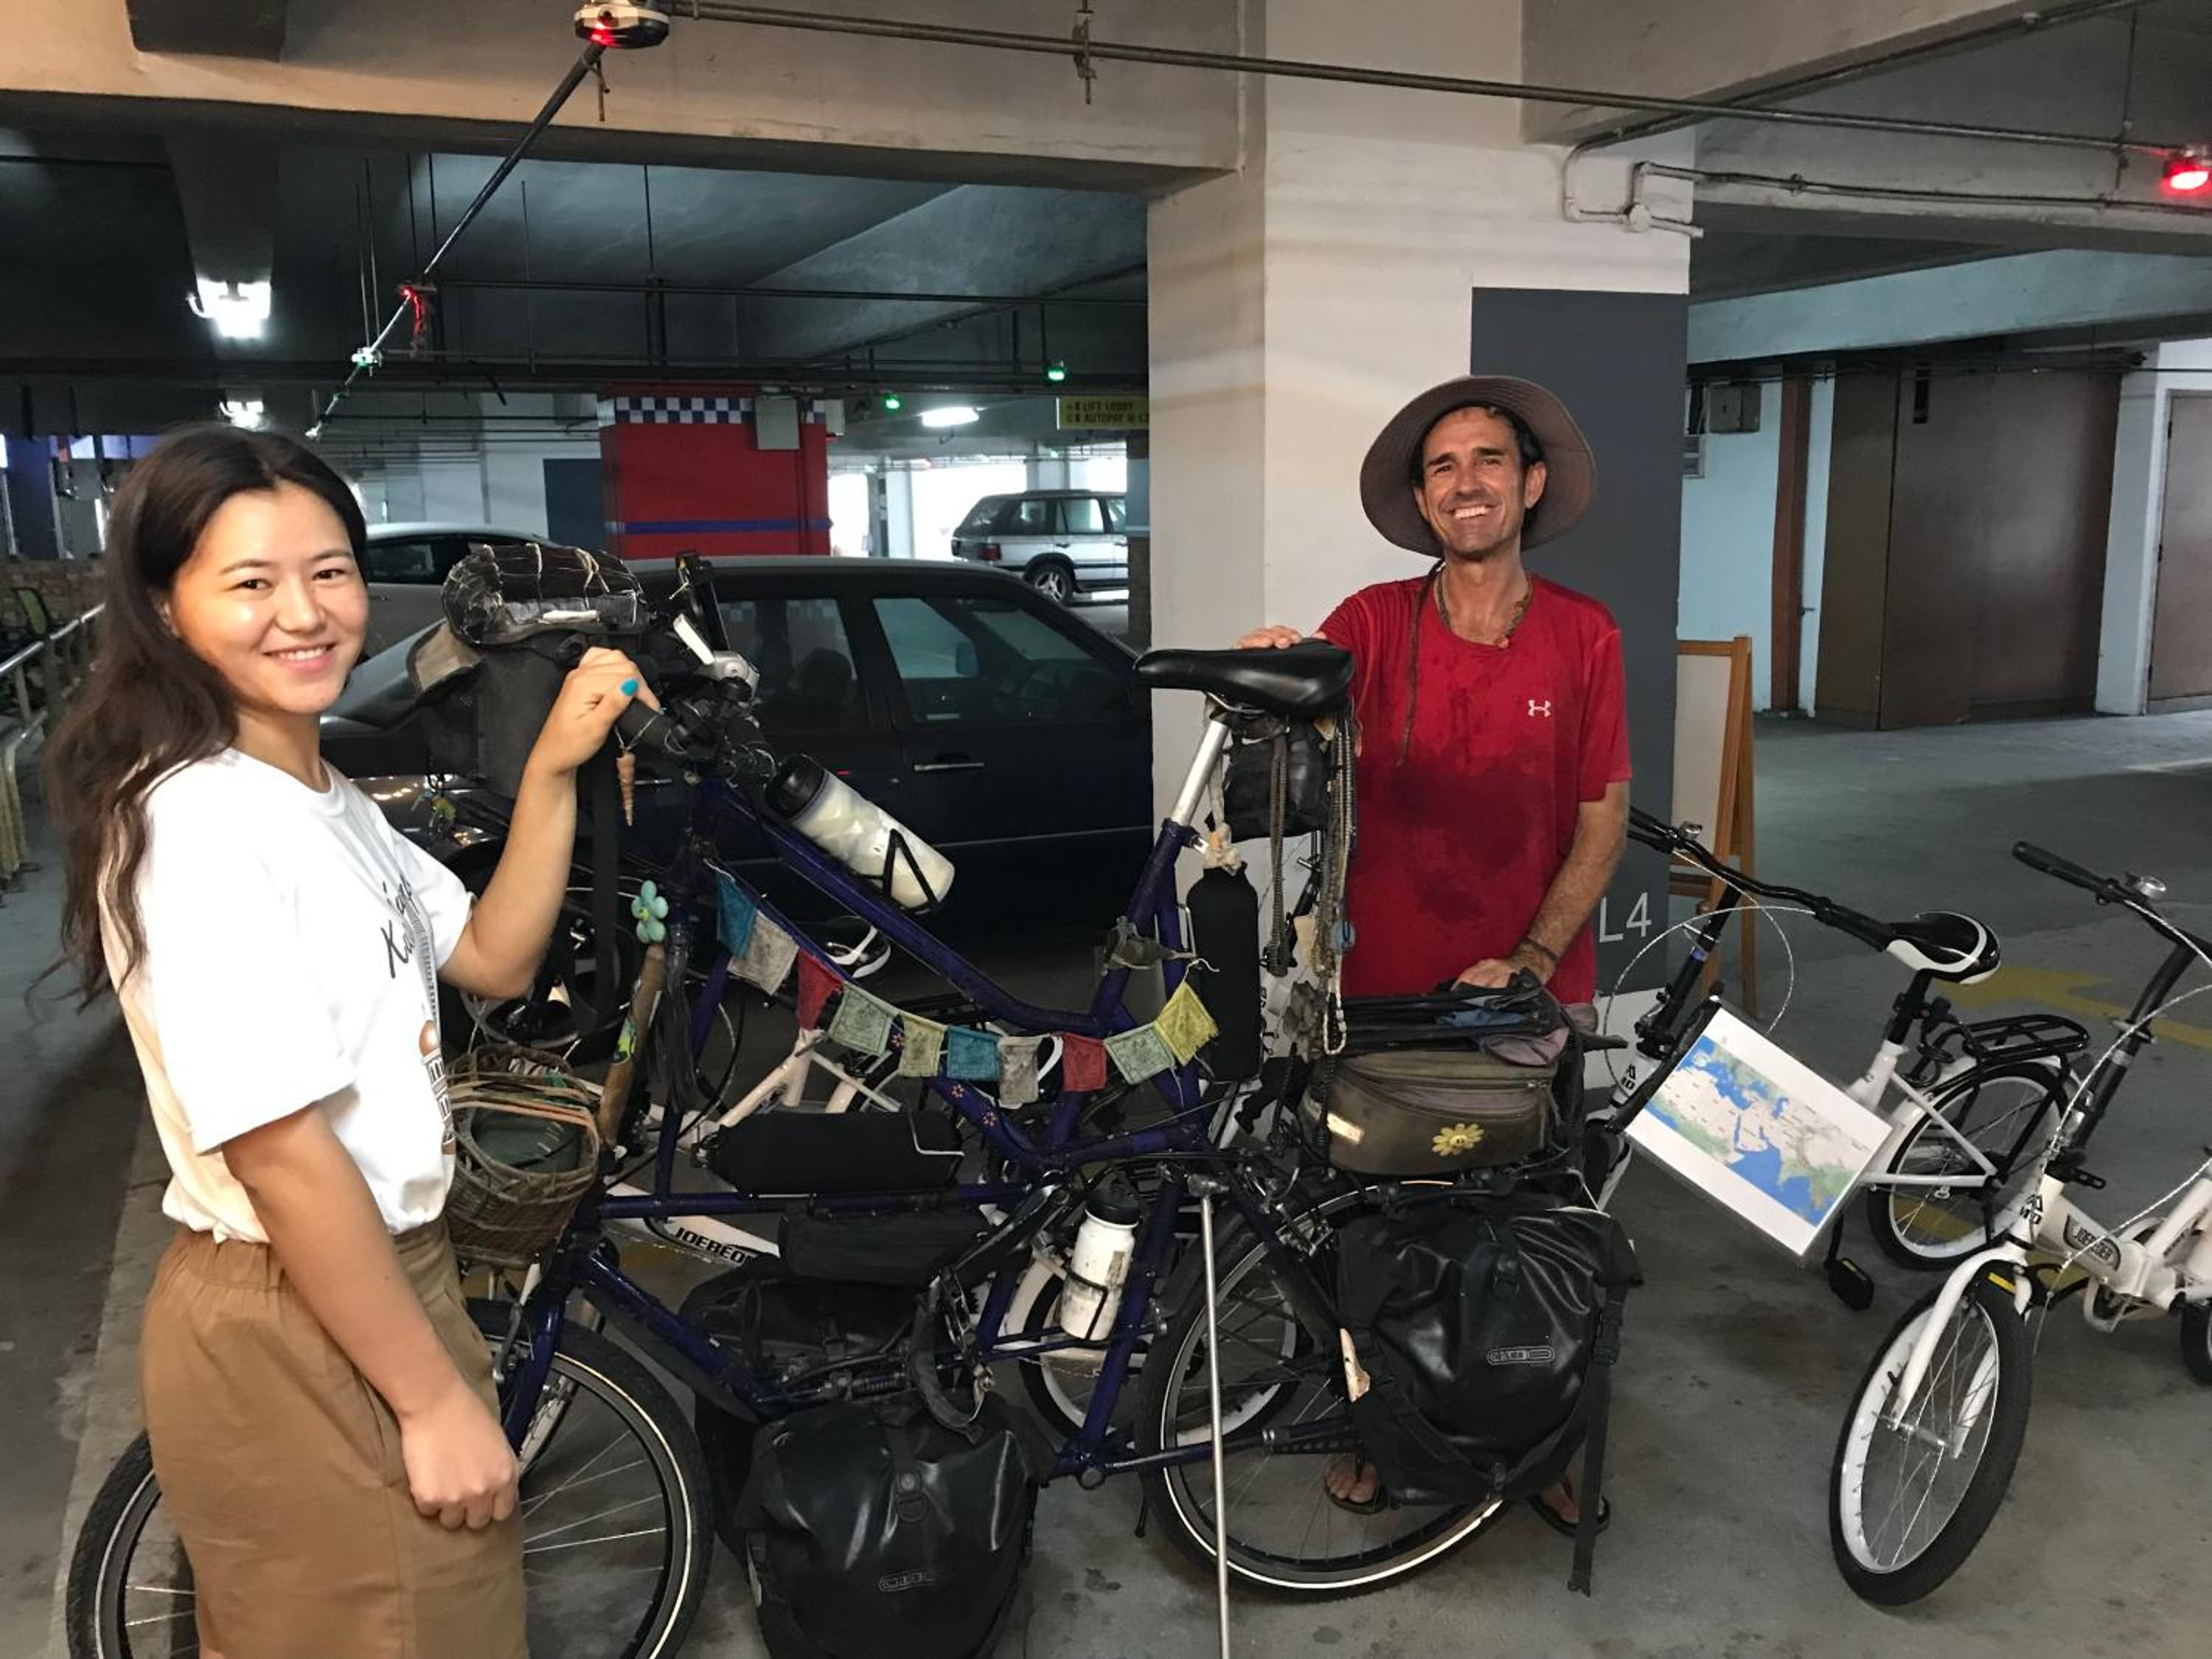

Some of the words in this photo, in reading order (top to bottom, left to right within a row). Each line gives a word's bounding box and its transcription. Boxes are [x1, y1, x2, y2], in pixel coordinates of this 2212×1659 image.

[1082, 401, 1101, 411] LIFT
[1105, 401, 1133, 411] LOBBY
[1084, 413, 1122, 422] AUTOPAY
[1599, 892, 1652, 942] L4
